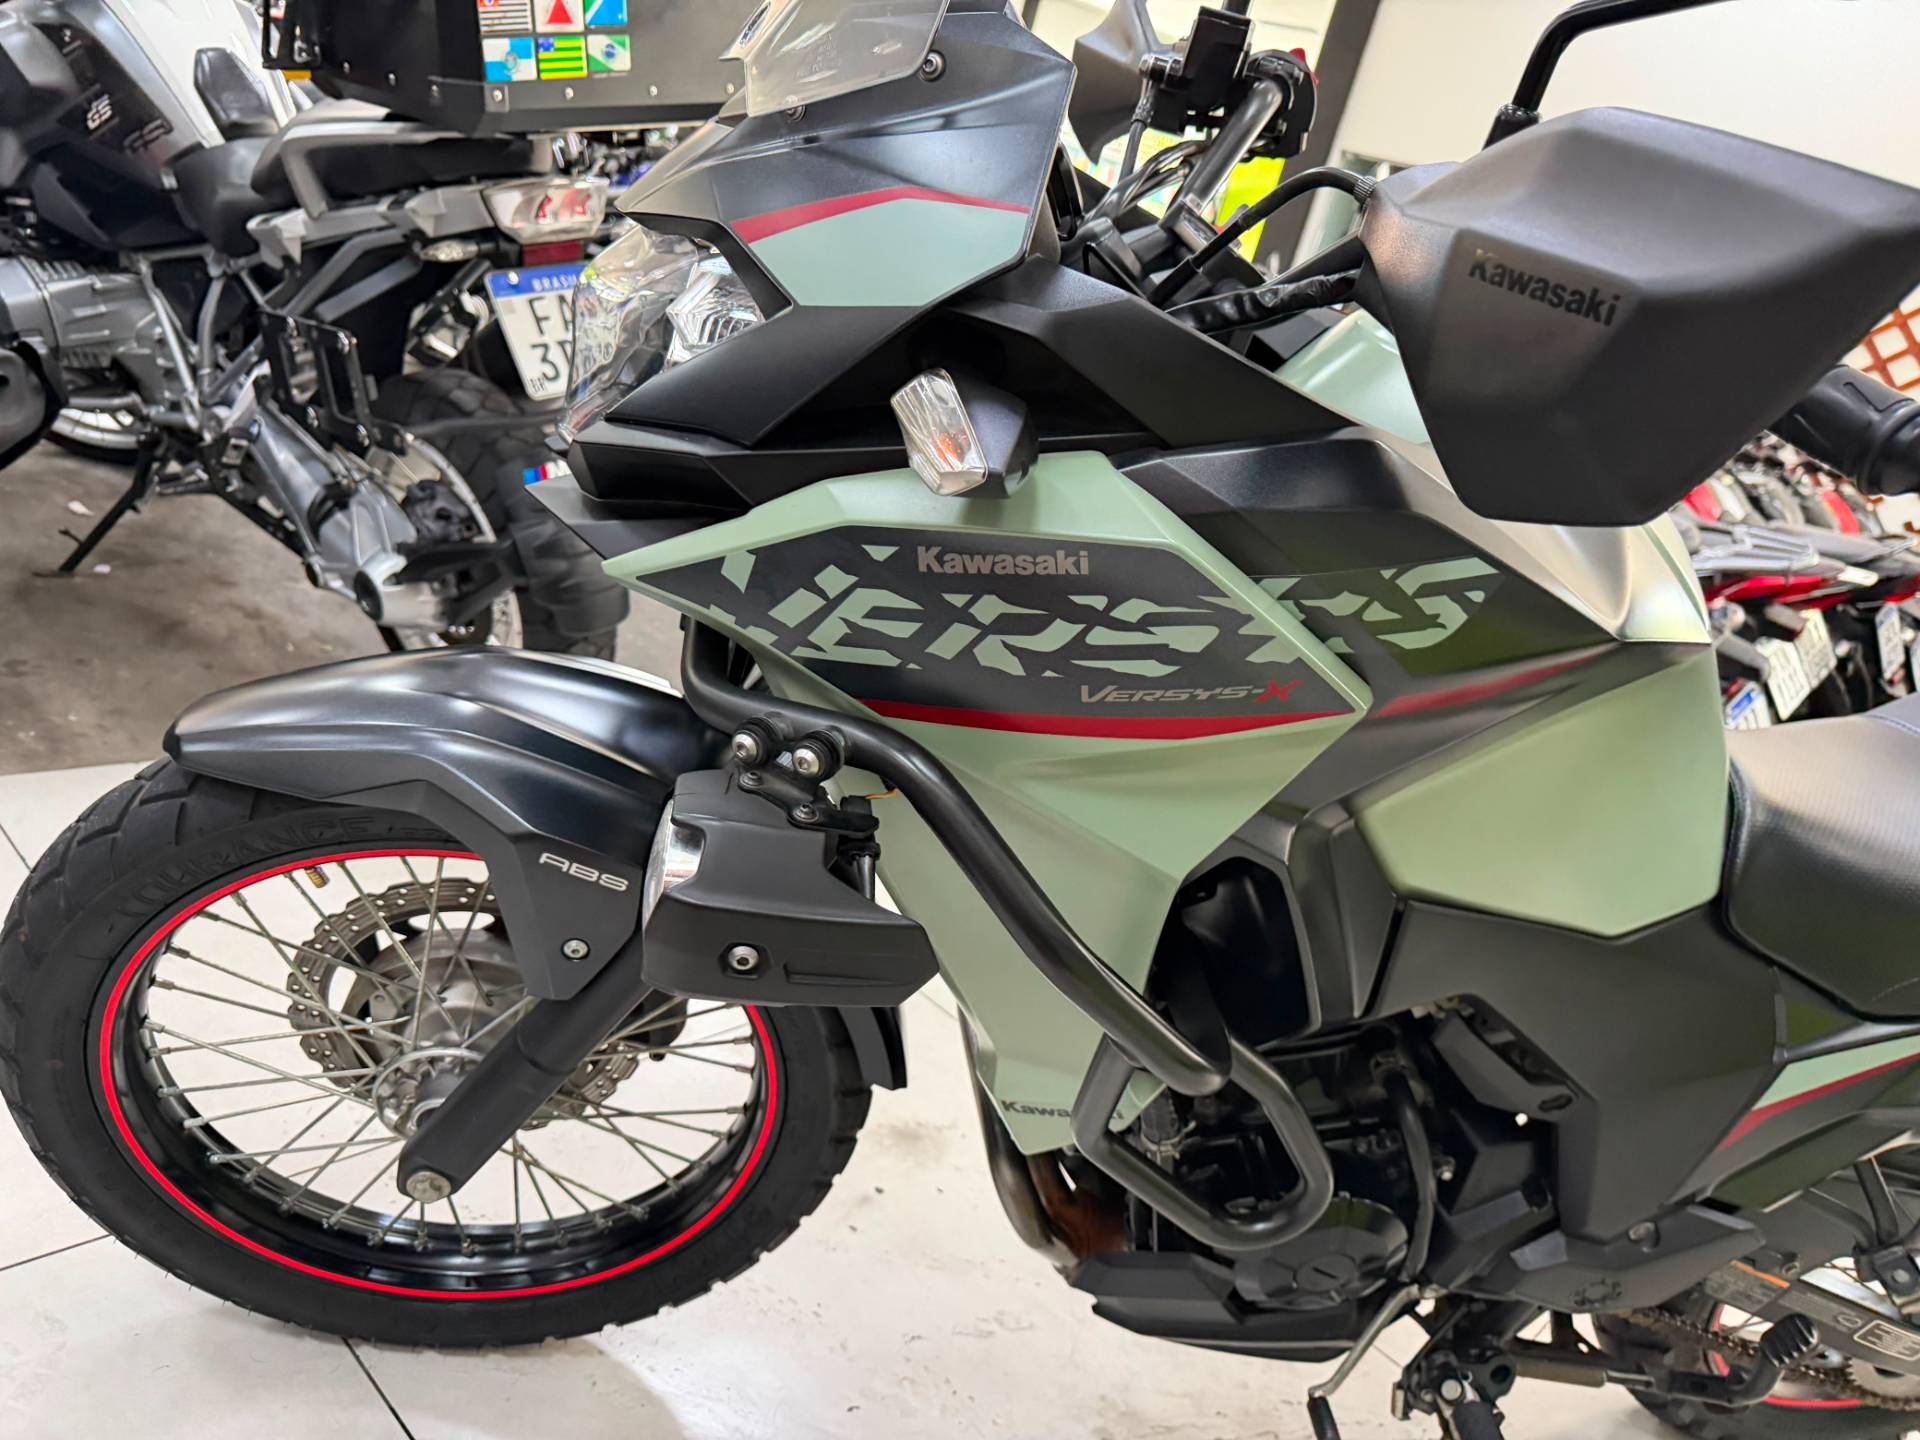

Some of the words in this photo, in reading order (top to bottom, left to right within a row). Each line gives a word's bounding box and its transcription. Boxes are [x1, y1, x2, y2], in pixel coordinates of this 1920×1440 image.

[1468, 249, 1622, 327] Kawasaki
[917, 545, 1090, 576] Kawasaki
[538, 852, 629, 891] ABS
[1001, 1100, 1125, 1121] Kawai
